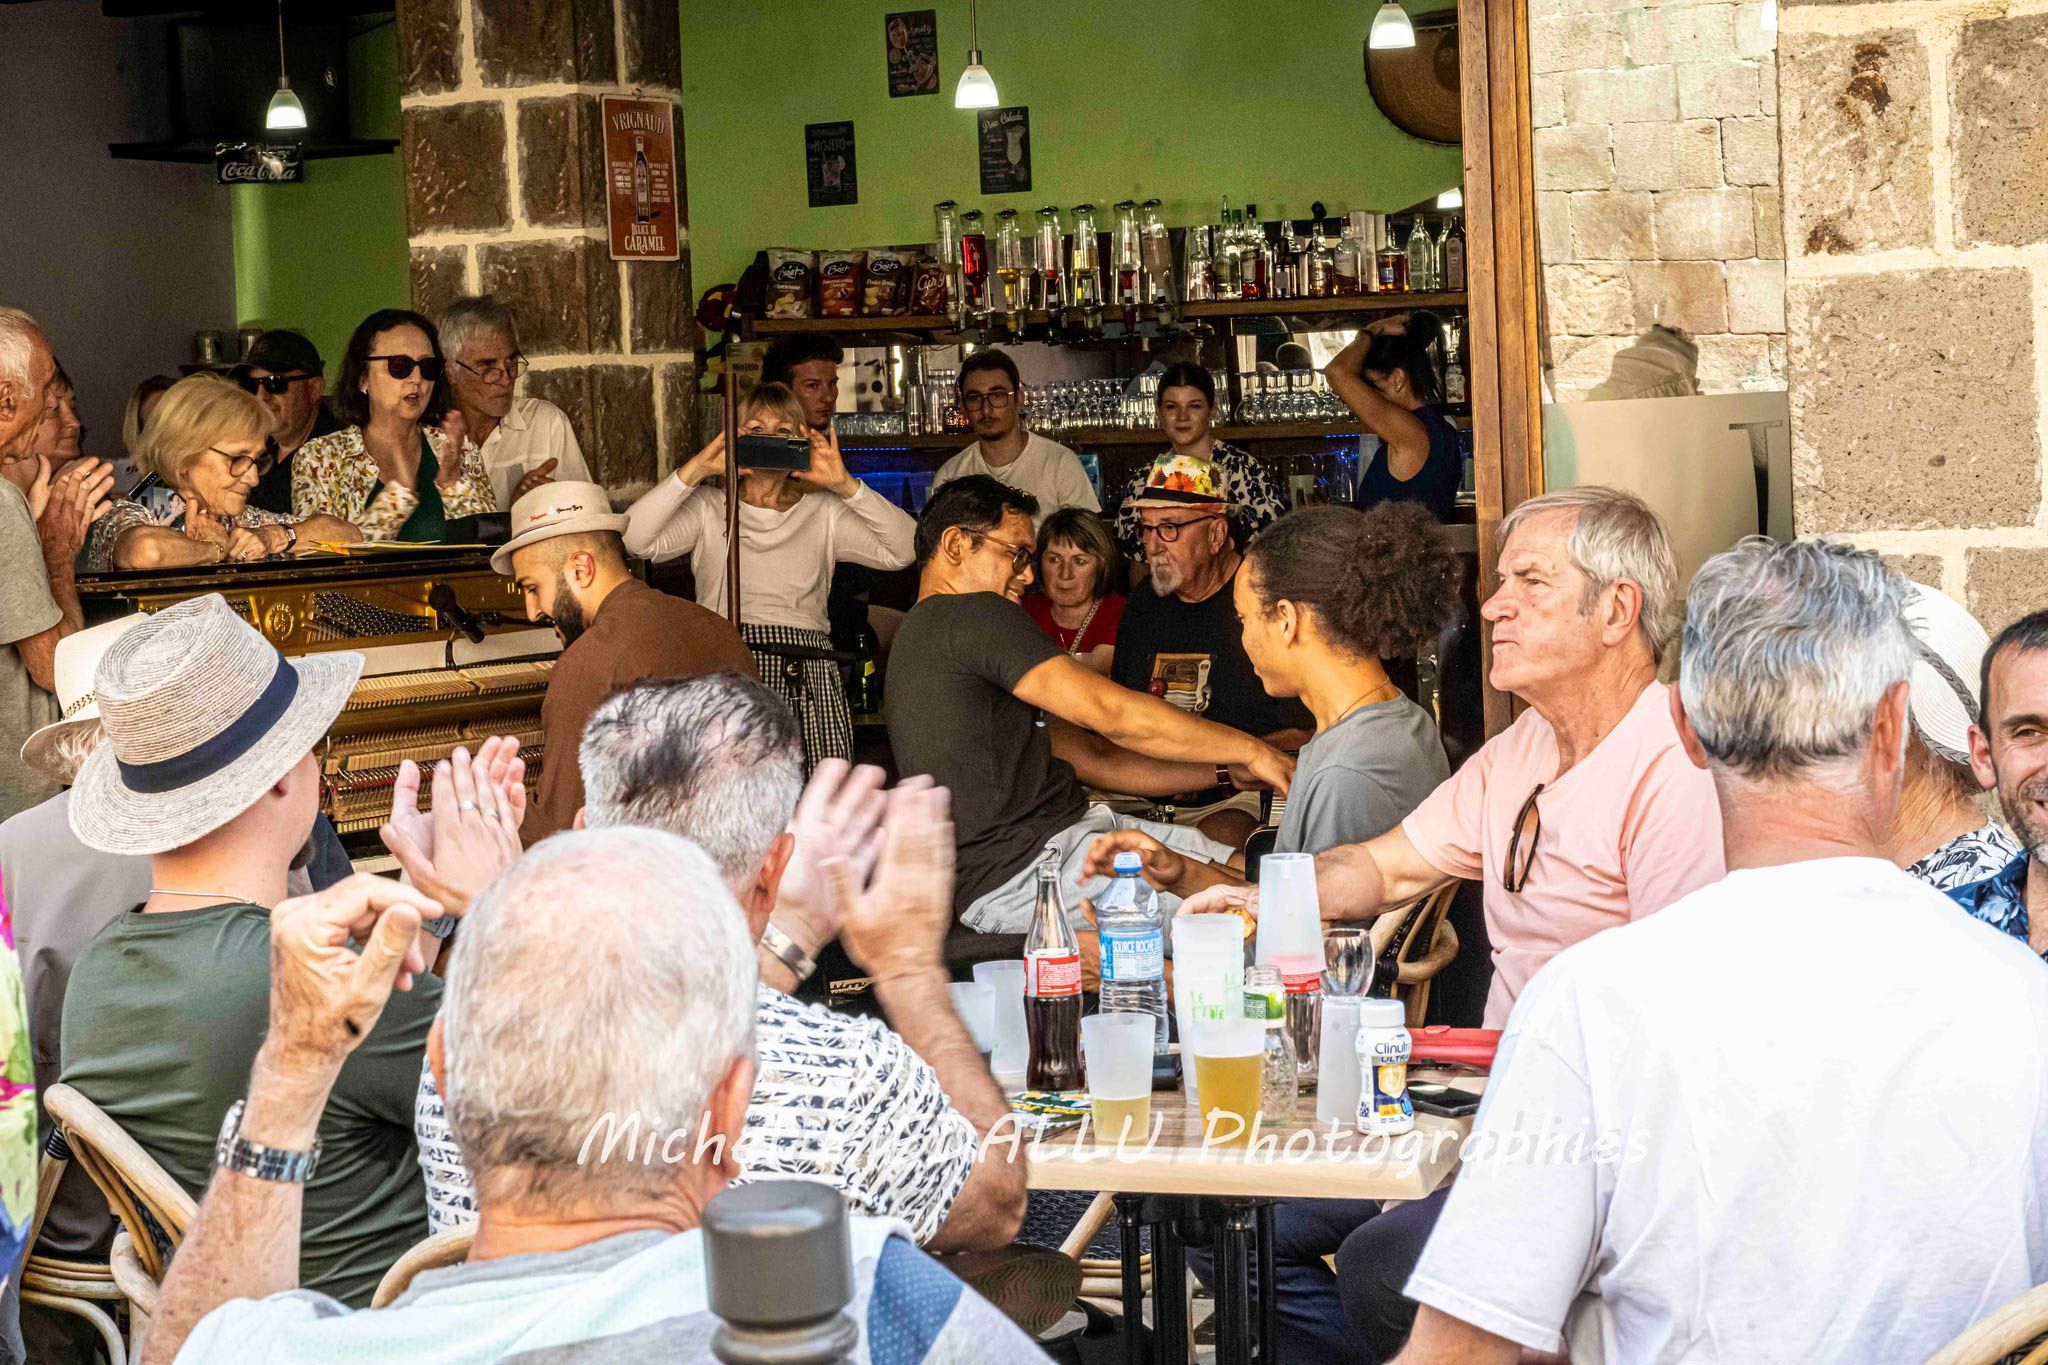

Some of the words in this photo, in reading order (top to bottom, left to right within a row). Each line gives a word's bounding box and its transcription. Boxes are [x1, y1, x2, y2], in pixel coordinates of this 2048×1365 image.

[612, 111, 665, 135] VRIGNAUD
[624, 235, 666, 254] CARAMEL
[917, 272, 946, 291] Cury
[1113, 940, 1135, 953] SOURCE
